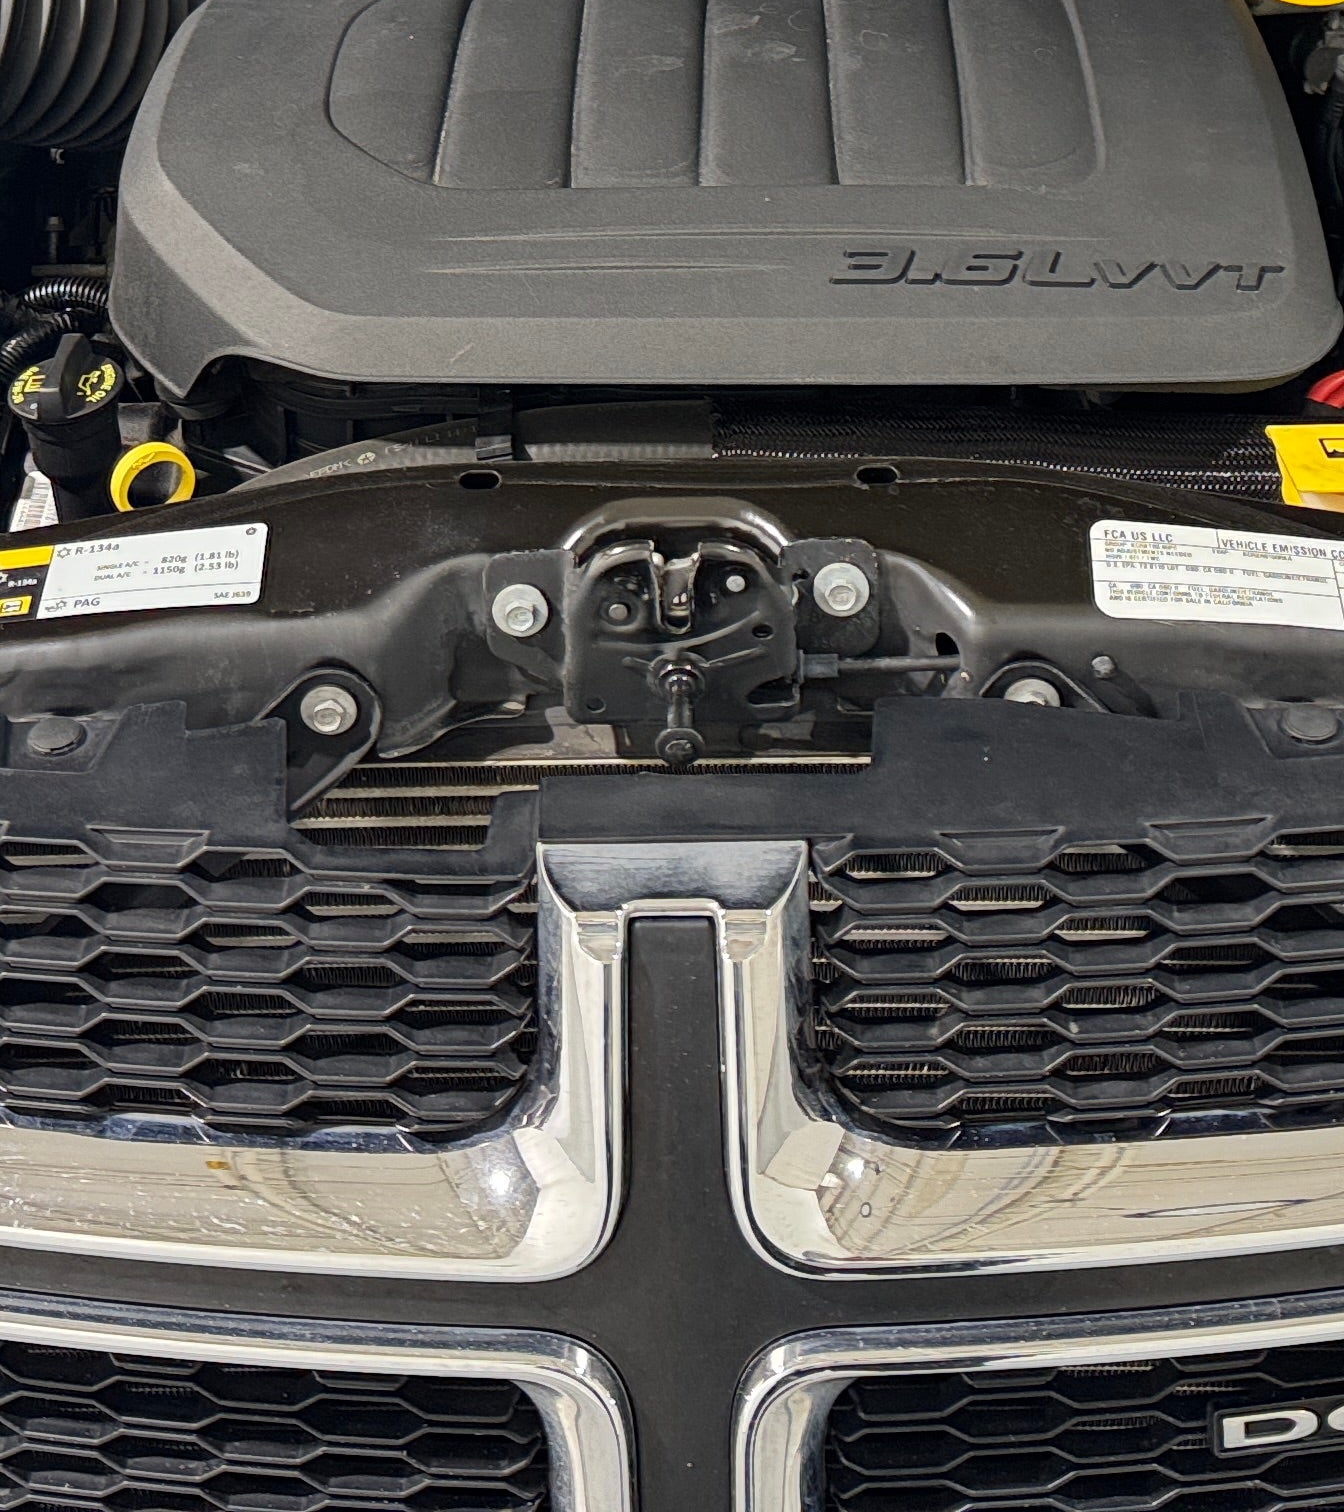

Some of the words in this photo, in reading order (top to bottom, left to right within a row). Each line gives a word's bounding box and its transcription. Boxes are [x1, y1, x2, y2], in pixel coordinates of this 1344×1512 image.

[1103, 529, 1127, 540] FCA
[1131, 531, 1148, 541] US
[1152, 532, 1173, 543] LLC
[74, 543, 120, 556] R-134a
[1221, 538, 1268, 552] VEHICLE
[1272, 543, 1327, 558] EMISSION
[73, 597, 101, 609] PAG
